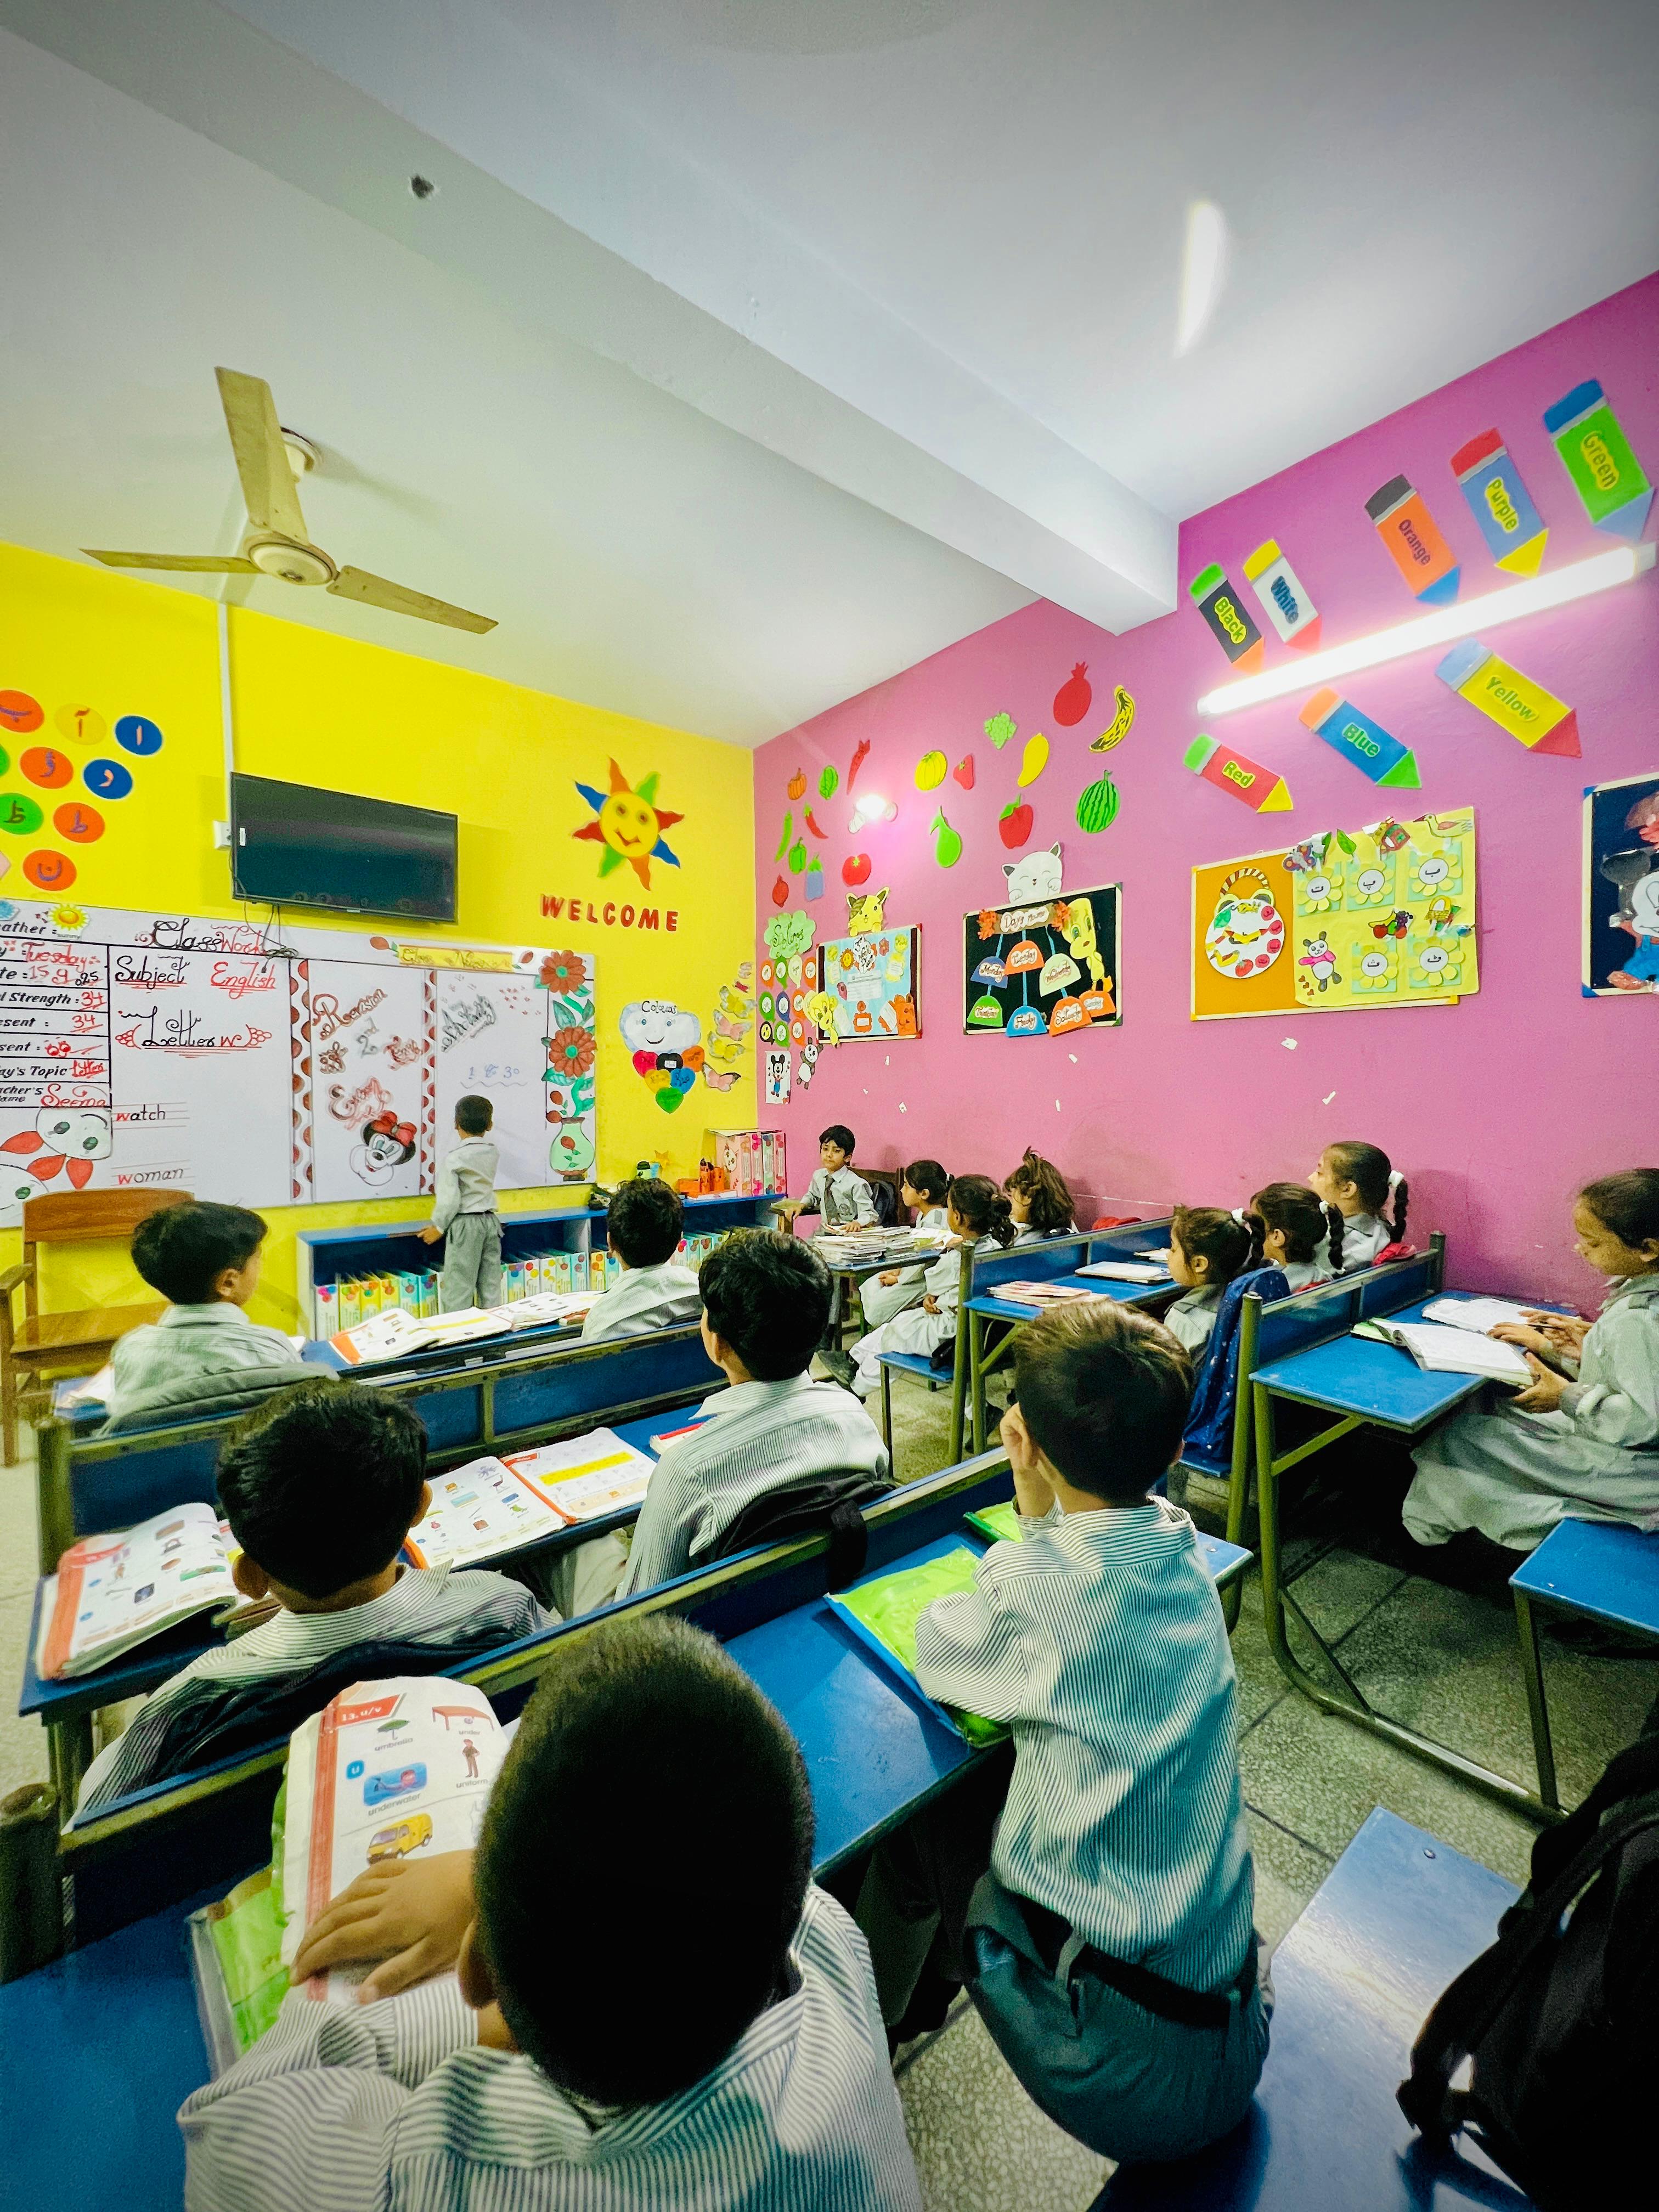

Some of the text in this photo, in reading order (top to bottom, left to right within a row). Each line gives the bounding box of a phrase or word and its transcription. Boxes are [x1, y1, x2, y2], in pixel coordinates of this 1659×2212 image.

[1583, 431, 1617, 488] Green
[1488, 479, 1517, 531] Purple
[1398, 519, 1431, 566] Orange
[1271, 576, 1298, 622] White
[1215, 598, 1244, 642] Black
[1485, 676, 1537, 721] Yellow
[1344, 725, 1379, 756] Blue
[1223, 761, 1253, 787] Red
[540, 893, 678, 932] WELCOME
[0, 921, 46, 935] ather
[114, 955, 276, 999] Subject English
[9, 991, 71, 1007] Strength
[81, 990, 104, 1007] 34
[71, 1013, 95, 1029] 34
[30, 1065, 68, 1079] Topic
[116, 1104, 166, 1122] watch
[118, 1168, 184, 1186] woman
[374, 1737, 414, 1751] umbrella
[456, 1779, 488, 1788] uniform
[368, 1792, 421, 1816] underwater
